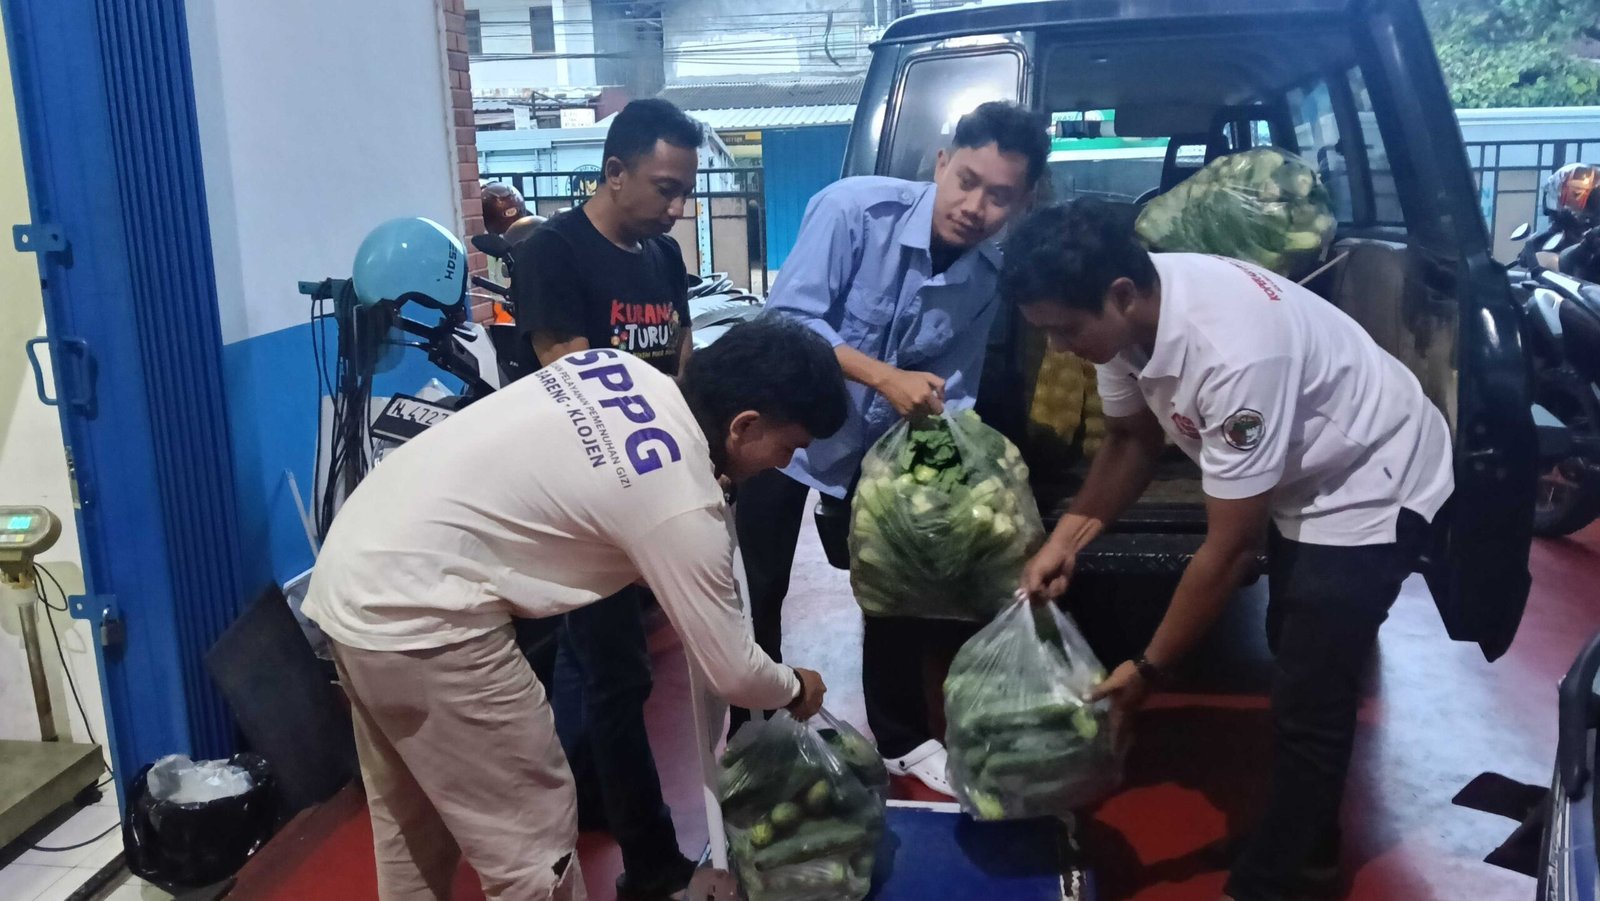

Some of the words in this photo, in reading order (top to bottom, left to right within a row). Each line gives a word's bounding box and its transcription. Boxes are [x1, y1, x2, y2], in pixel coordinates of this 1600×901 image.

[625, 323, 669, 350] TURU
[565, 350, 681, 475] SPPG
[567, 408, 607, 468] KLOJEN
[586, 403, 621, 465] PEMENUHAN
[616, 466, 632, 489] GIZI
